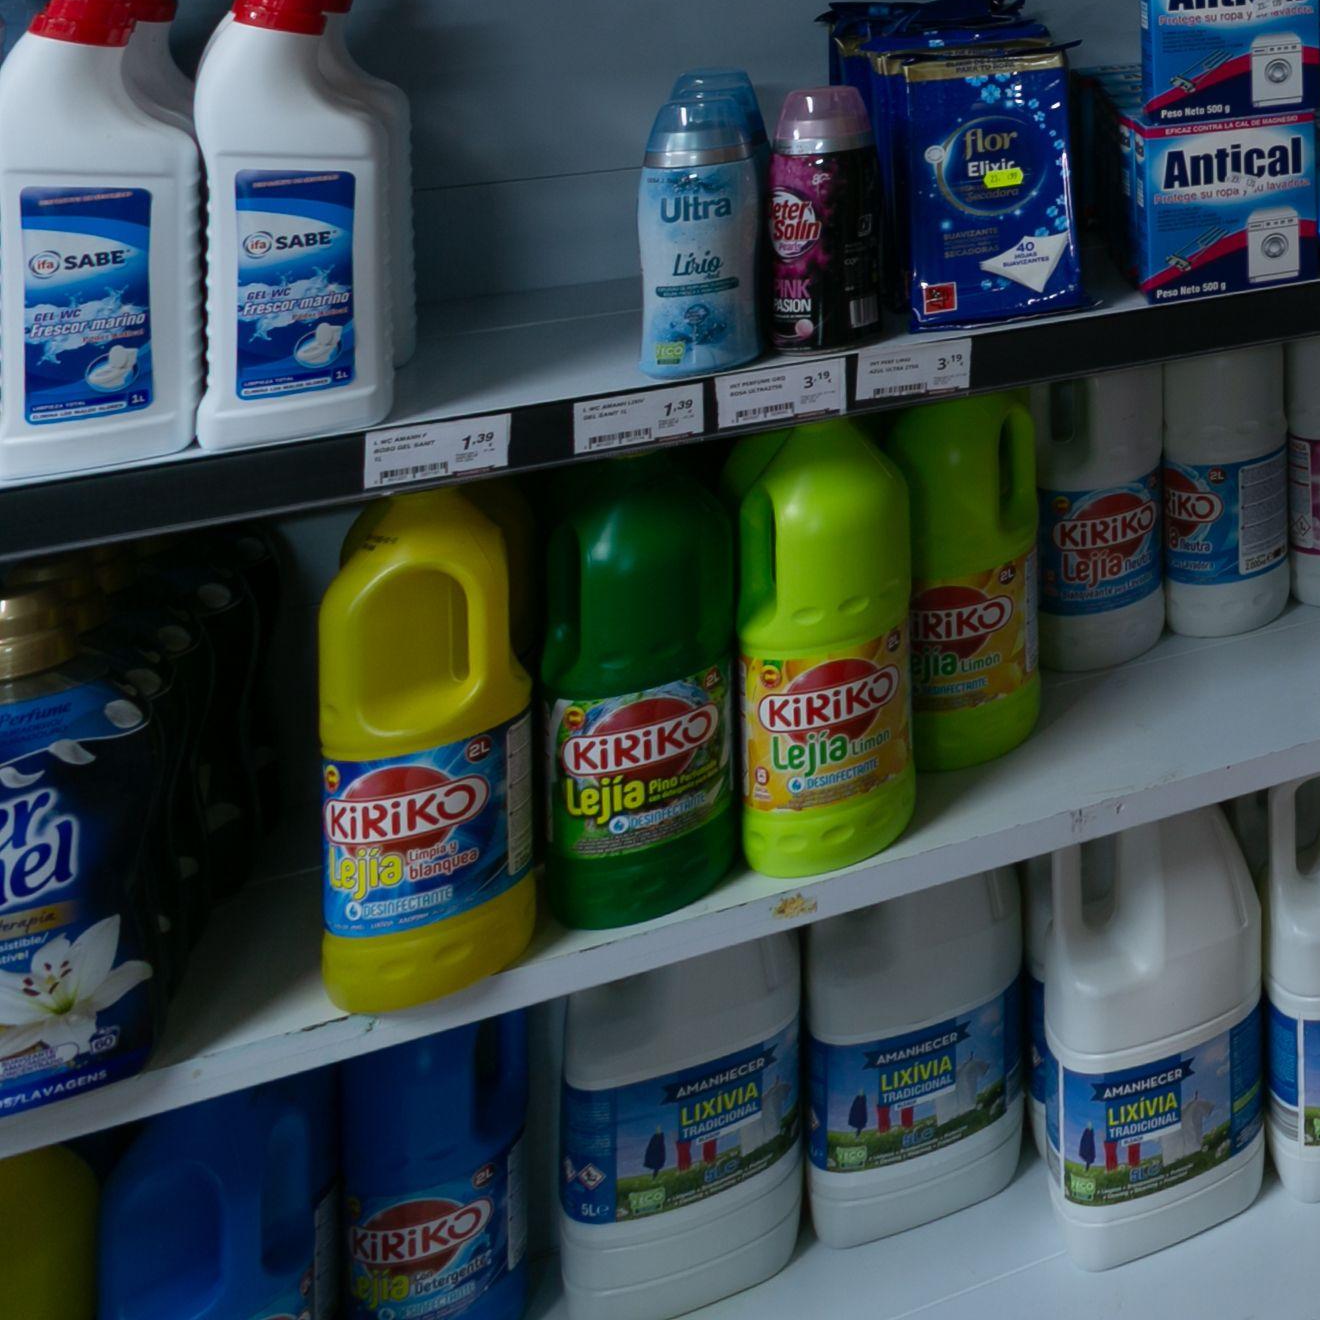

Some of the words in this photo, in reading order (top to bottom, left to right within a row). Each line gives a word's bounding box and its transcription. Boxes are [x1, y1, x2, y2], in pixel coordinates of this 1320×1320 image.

[1158, 13, 1202, 26] Protege
[1204, 13, 1218, 23] su
[1220, 12, 1244, 24] ropa
[1160, 107, 1183, 119] Peso
[1185, 106, 1204, 117] Neto
[1205, 104, 1221, 116] 500
[962, 127, 1018, 160] flor
[1163, 136, 1302, 189] Antical
[660, 194, 732, 224] Ultra
[249, 238, 267, 251] ifa
[275, 231, 332, 250] SABE
[1016, 241, 1036, 252] 40
[35, 258, 54, 271] ifa
[64, 250, 126, 271] SABE
[243, 300, 297, 317] Frescor
[301, 290, 350, 309] marino
[30, 319, 90, 338] Frescor
[92, 311, 145, 331] marino
[461, 430, 495, 451] 1,39
[771, 731, 848, 777] Lejía
[851, 728, 890, 756] Limón
[566, 775, 645, 825] Lejía
[329, 845, 404, 901] Lejía
[409, 848, 479, 882] blanquea
[880, 1054, 954, 1093] LIXÍVIA
[882, 1073, 953, 1104] TRADICIONAL
[680, 1082, 760, 1126] LIXÍVIA
[1107, 1092, 1179, 1126] LIXÍVIA
[682, 1101, 760, 1139] TRADICIONAL
[1108, 1110, 1180, 1139] TRADICIONAL
